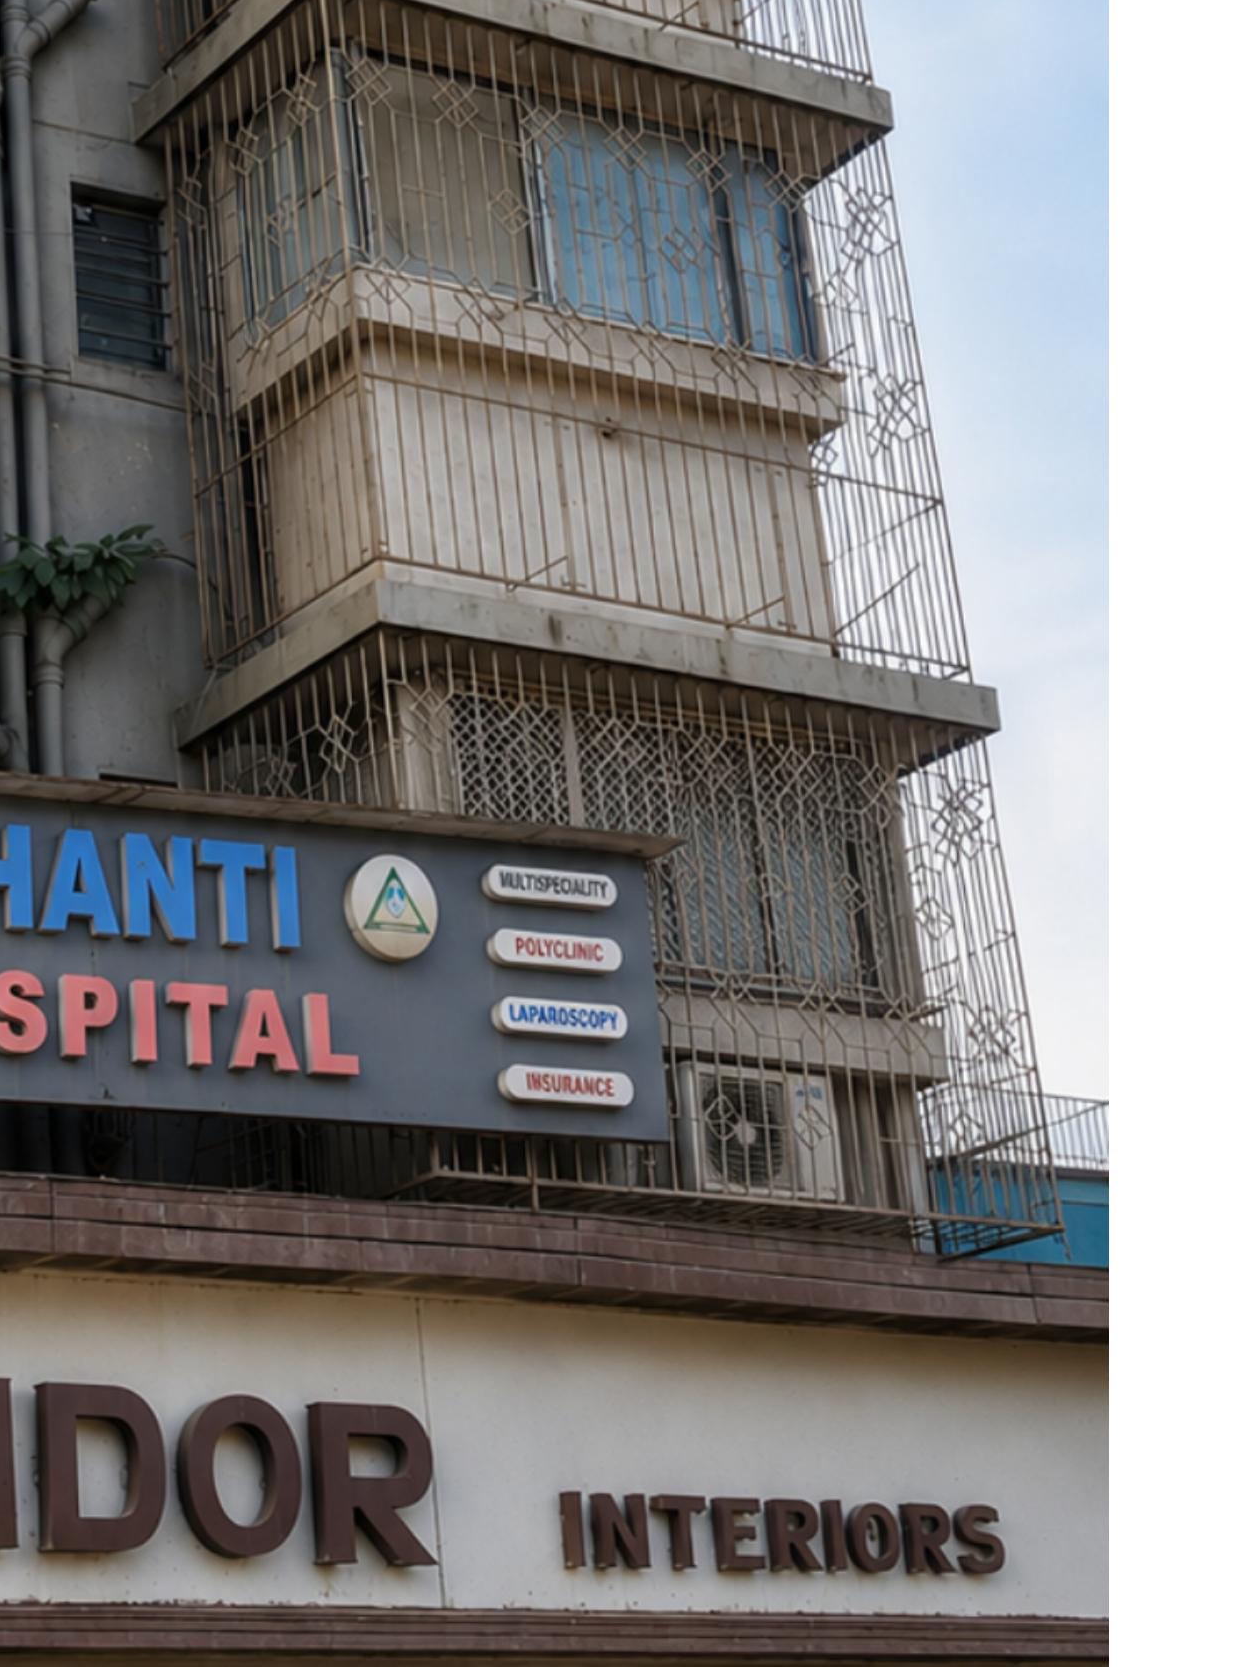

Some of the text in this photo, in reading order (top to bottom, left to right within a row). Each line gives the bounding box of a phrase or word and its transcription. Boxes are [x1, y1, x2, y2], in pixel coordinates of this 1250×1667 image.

[516, 937, 604, 962] POLYCLINIC
[509, 1004, 618, 1030] LAPAROSCOPY
[526, 1072, 615, 1097] INSURANCE
[558, 1490, 1007, 1575] INTERIORS
